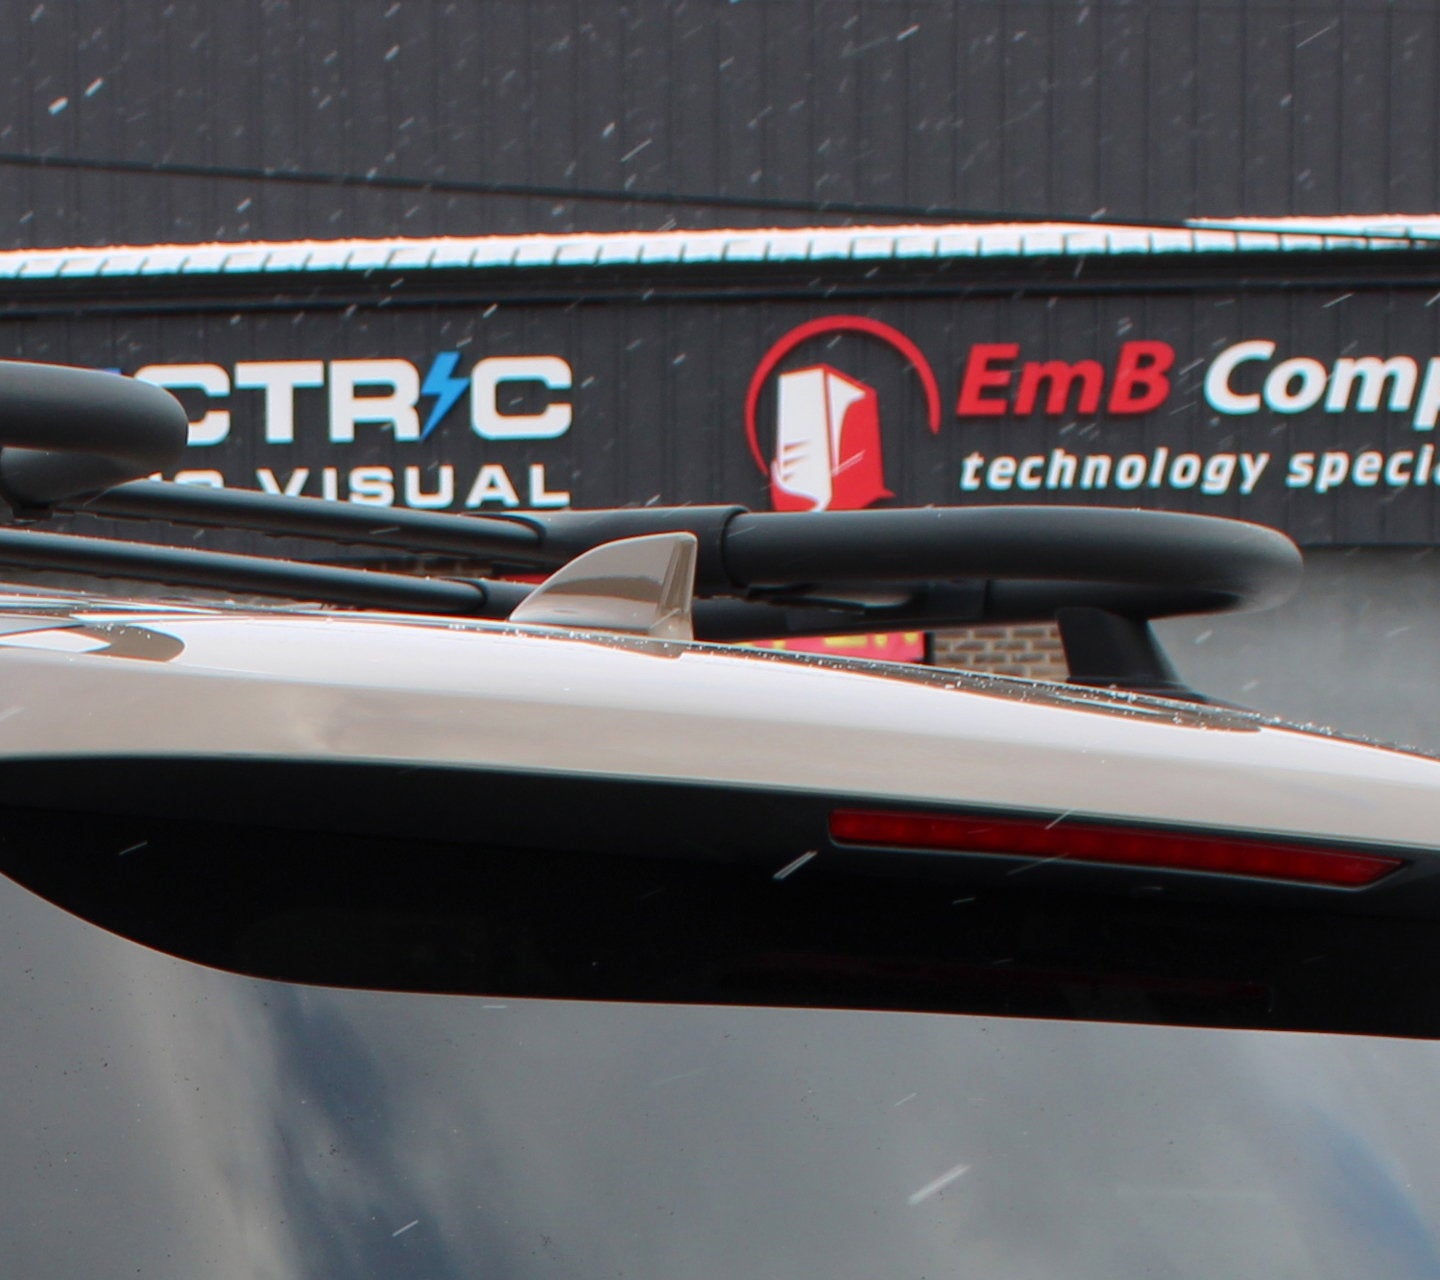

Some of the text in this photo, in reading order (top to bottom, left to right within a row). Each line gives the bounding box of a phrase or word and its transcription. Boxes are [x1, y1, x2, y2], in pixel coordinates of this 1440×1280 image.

[957, 340, 1173, 416] EmB
[256, 463, 571, 508] VISUAL
[960, 446, 1268, 496] technology
